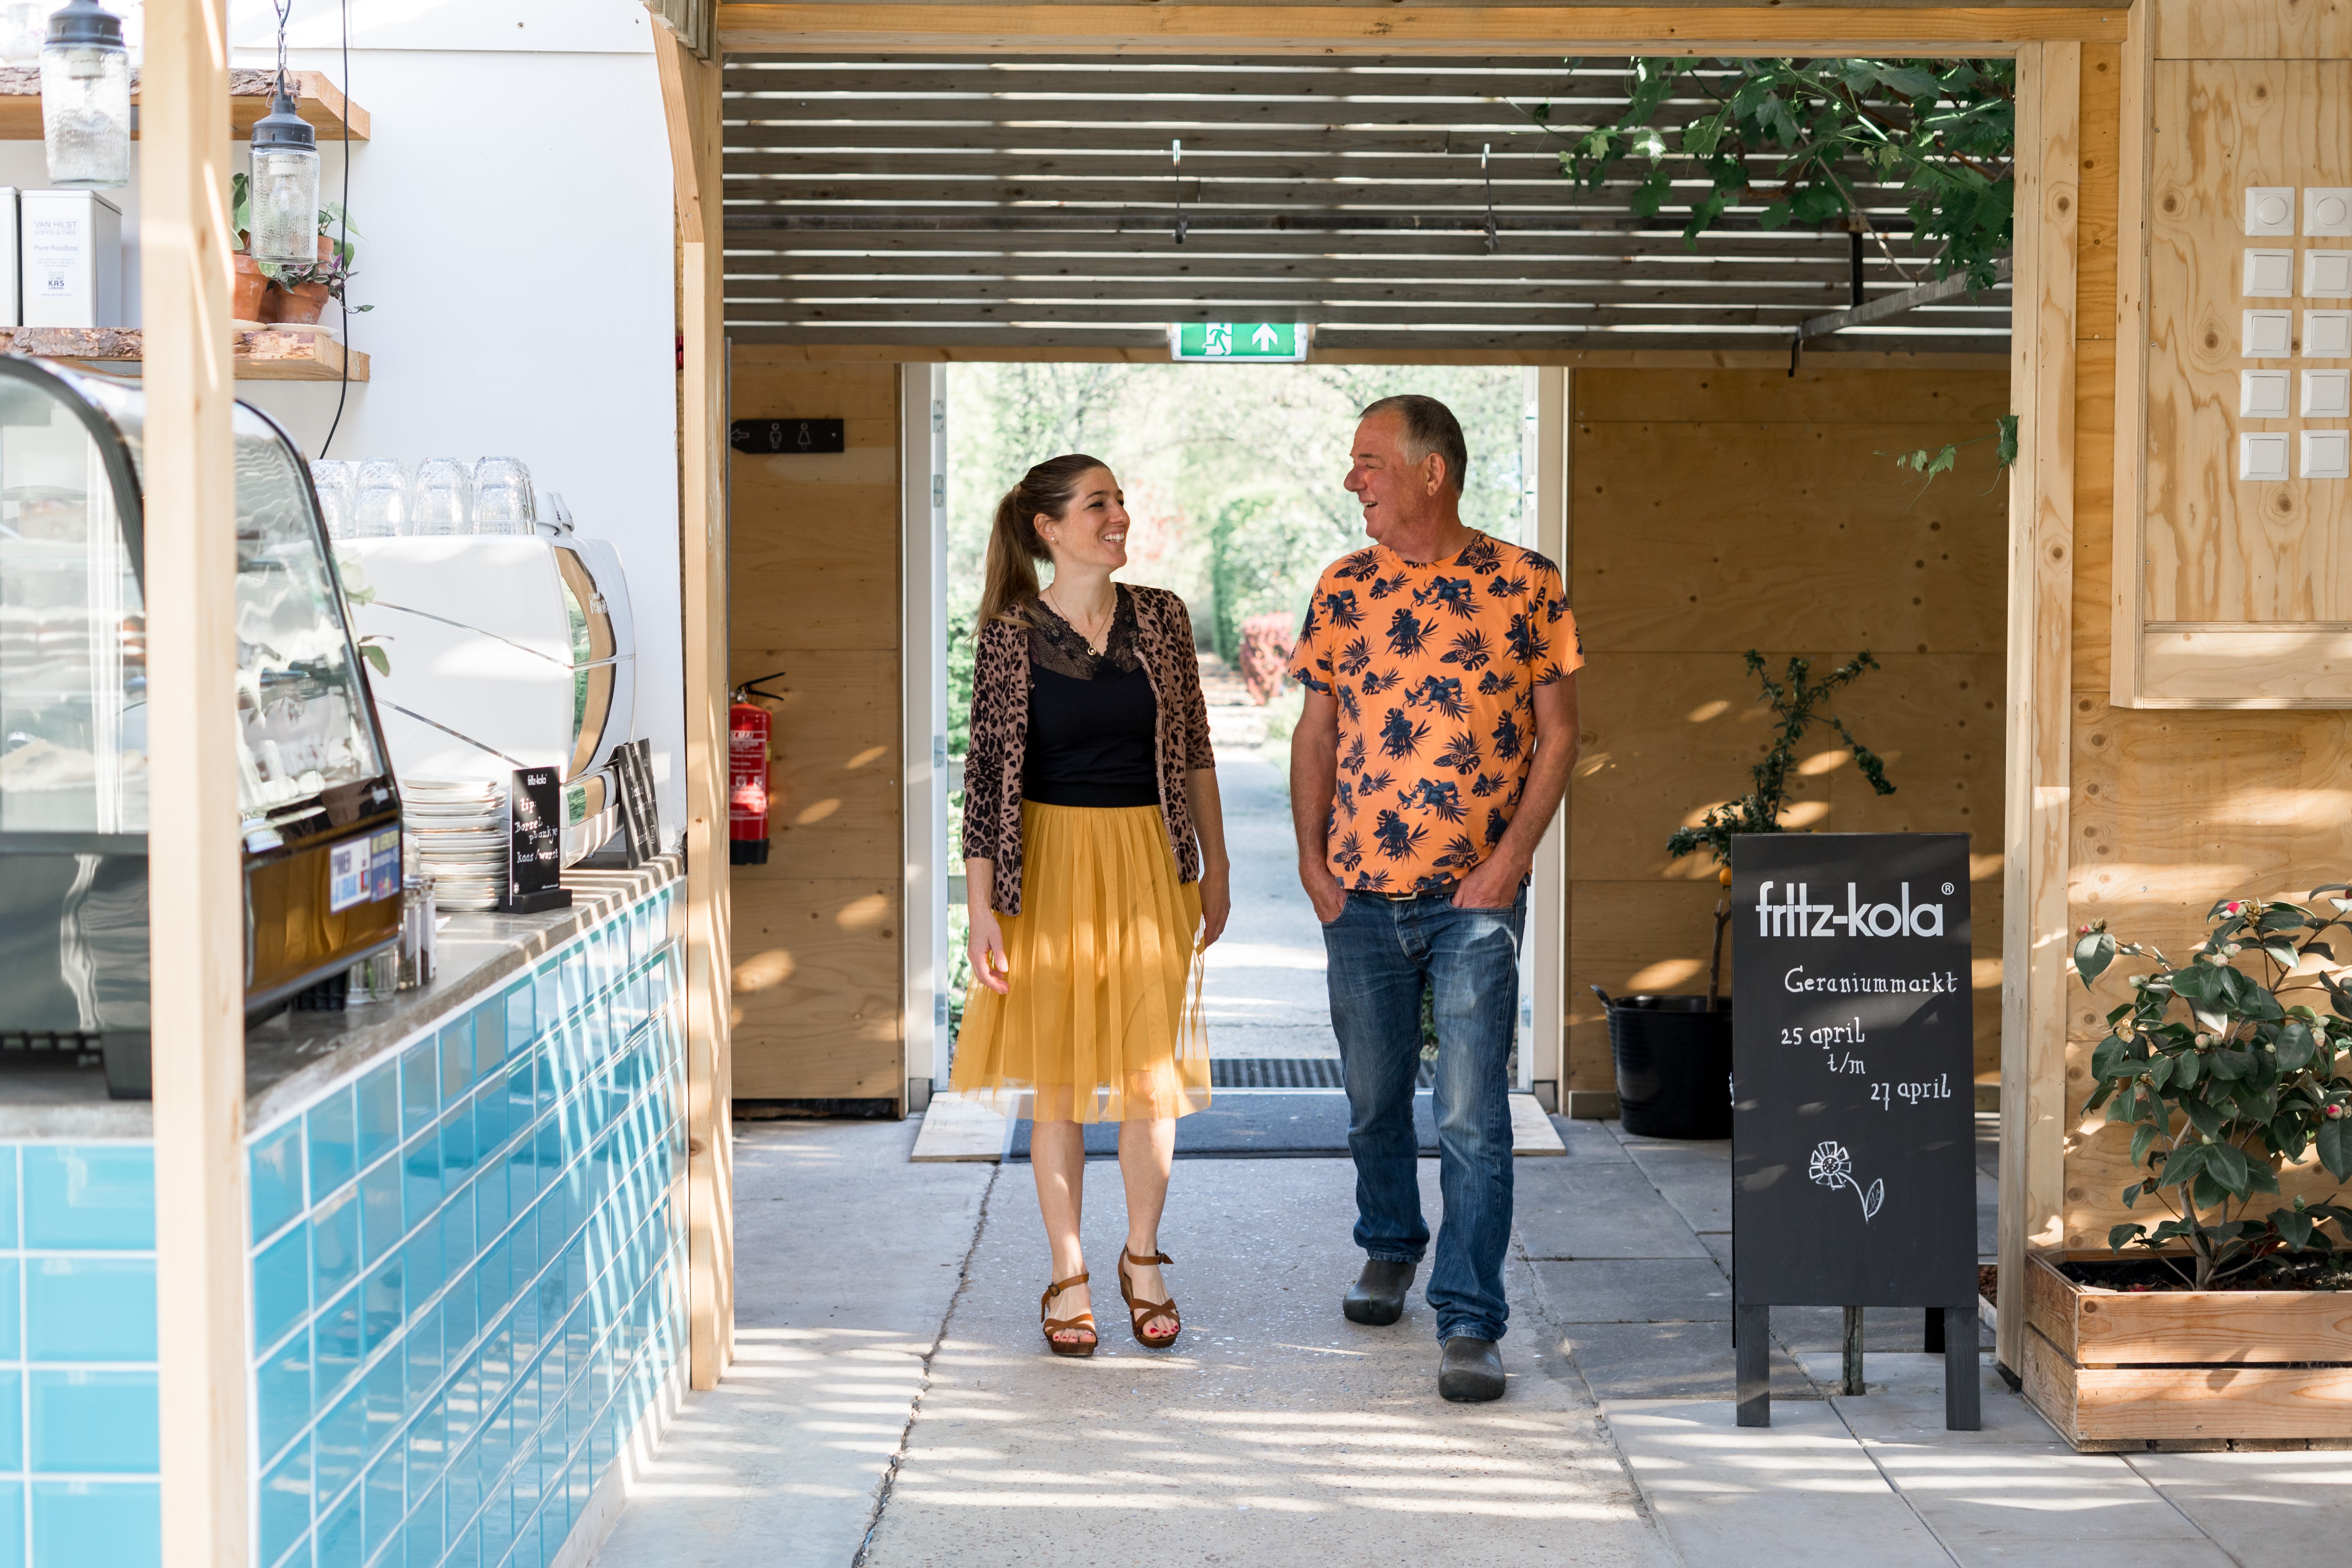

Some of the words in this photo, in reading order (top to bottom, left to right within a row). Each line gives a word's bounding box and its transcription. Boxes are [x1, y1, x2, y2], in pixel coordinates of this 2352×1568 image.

[520, 798, 537, 814] tip:
[517, 851, 534, 863] kaas
[1785, 965, 1958, 993] Geraniummarkt
[1781, 1028, 1803, 1045] 25
[1810, 1017, 1864, 1049] april
[1827, 1052, 1865, 1074] t/m
[1871, 1083, 1890, 1111] 27
[1897, 1073, 1951, 1104] april
